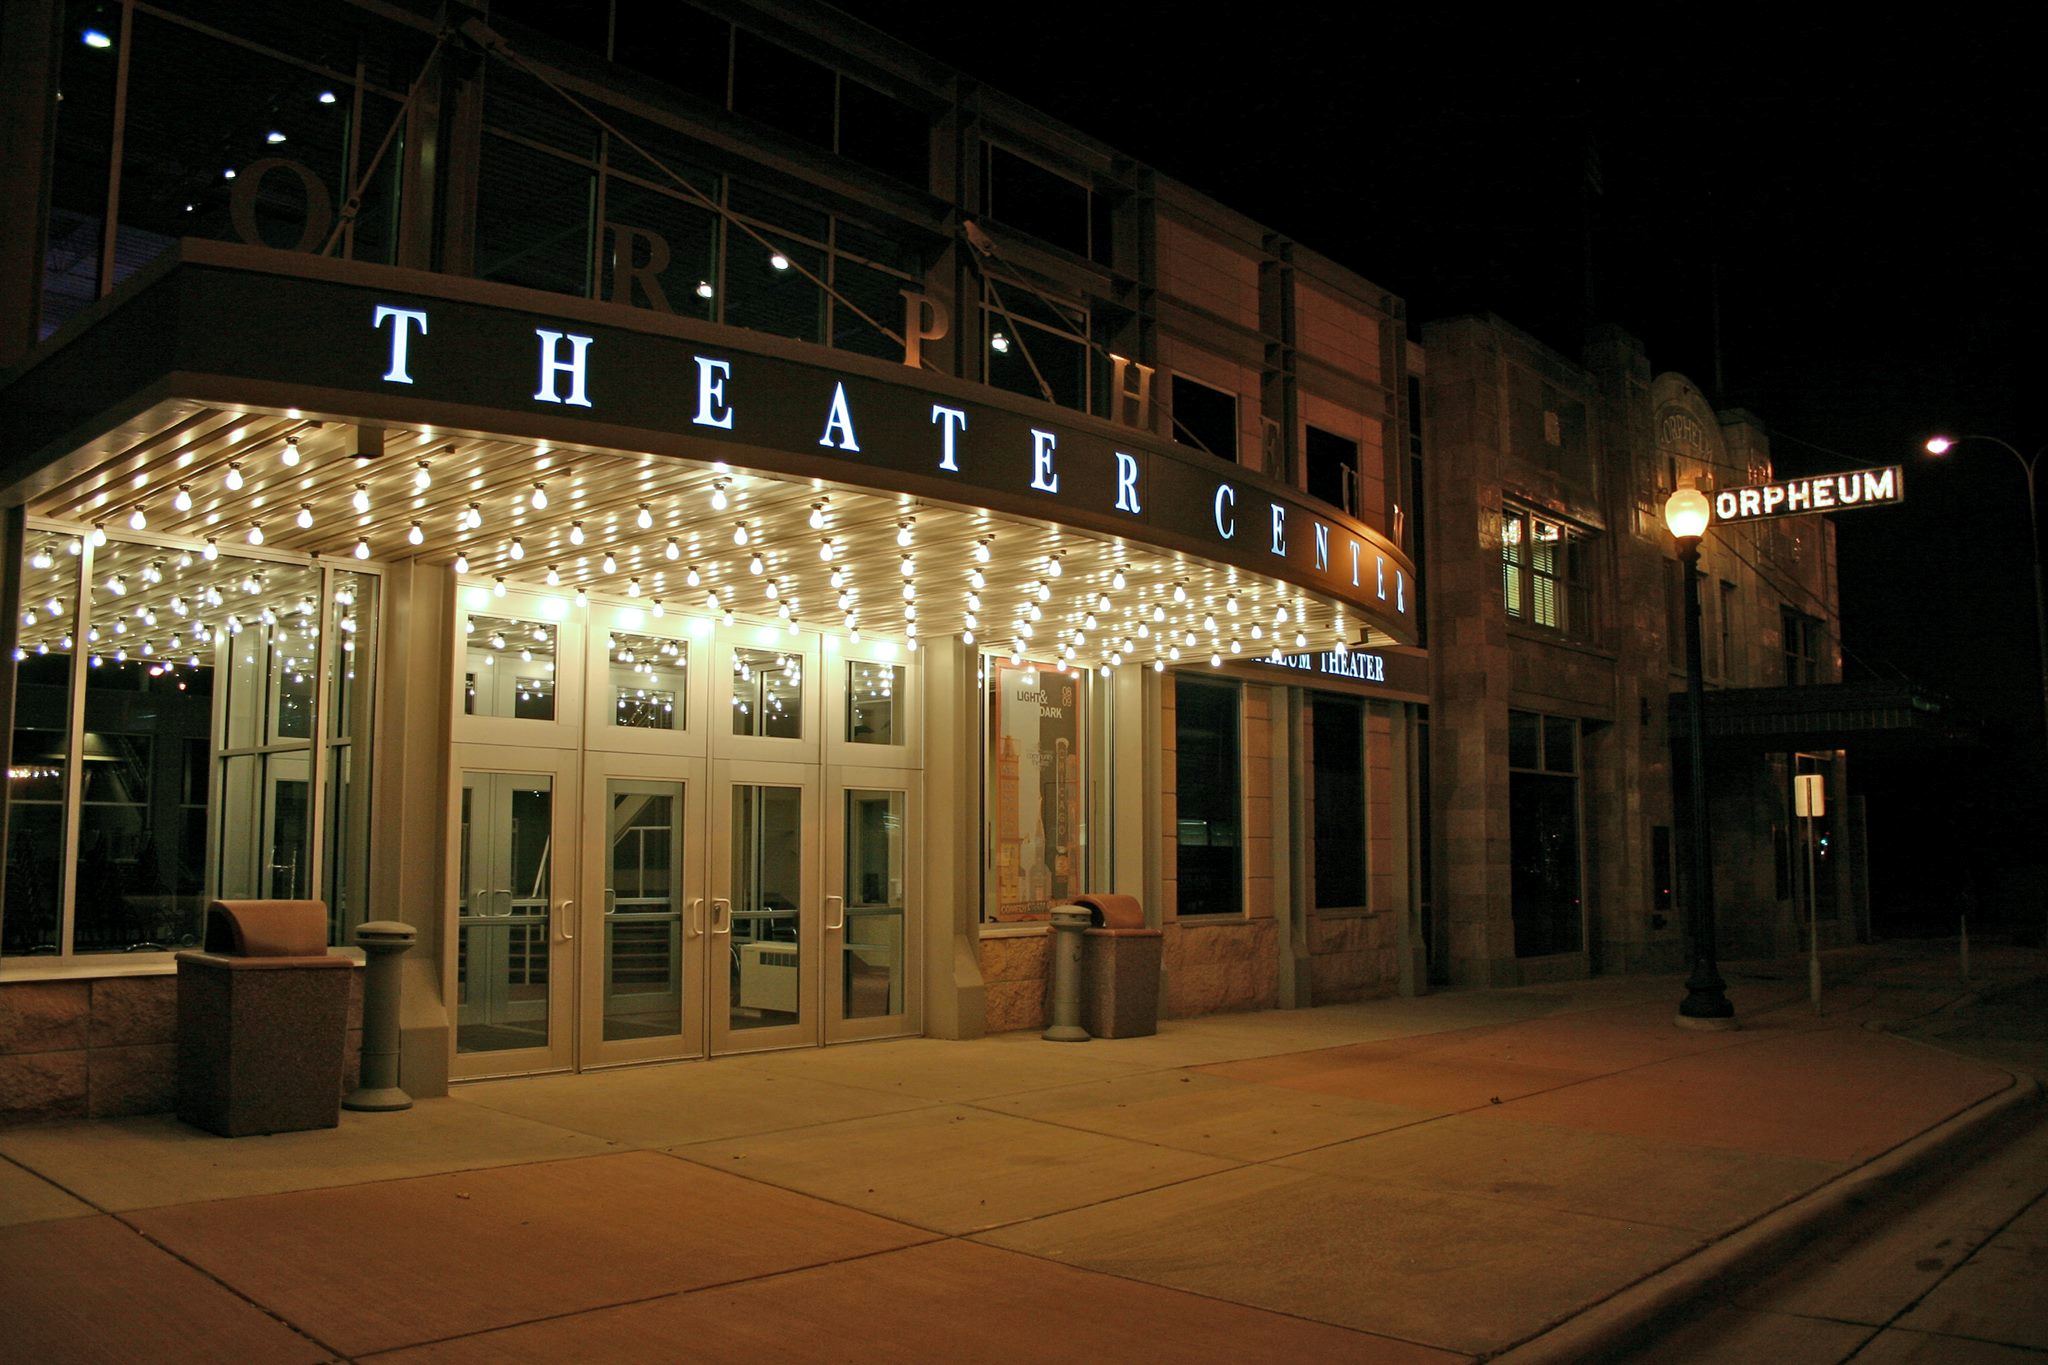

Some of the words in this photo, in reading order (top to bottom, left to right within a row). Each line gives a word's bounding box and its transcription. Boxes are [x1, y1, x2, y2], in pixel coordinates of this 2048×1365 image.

[373, 305, 1141, 514] THEATER
[1214, 483, 1405, 614] CENTER
[1716, 467, 1895, 519] ORPHEUM
[1320, 651, 1385, 682] THEATER
[1039, 706, 1063, 719] DARK
